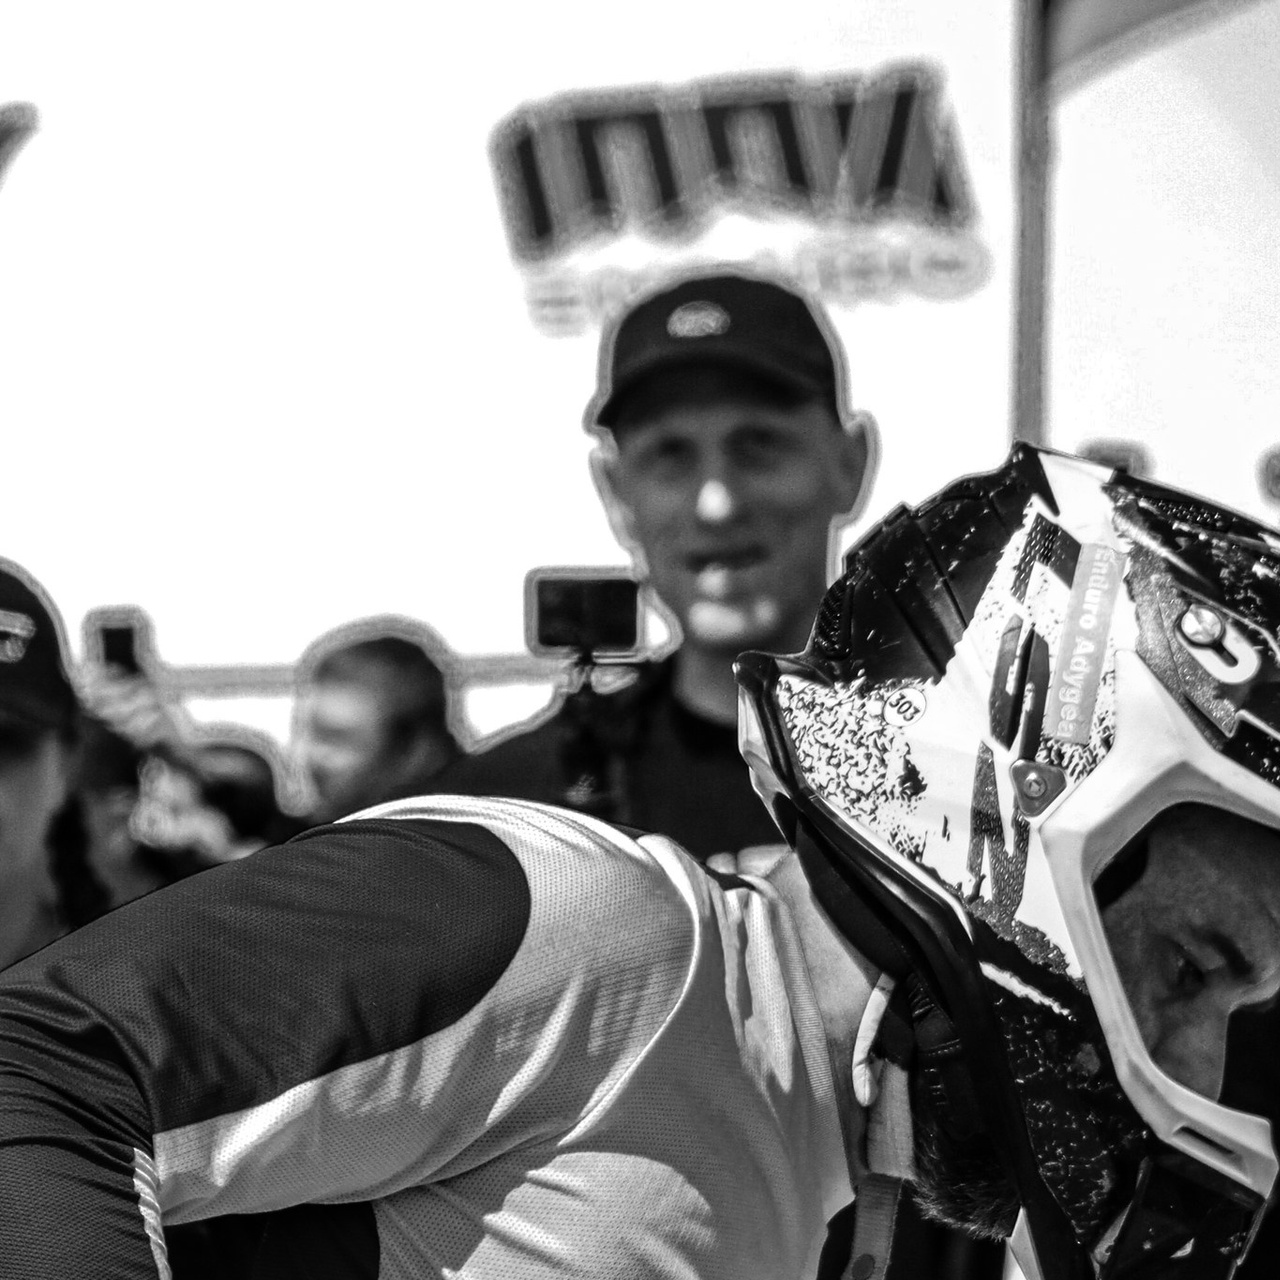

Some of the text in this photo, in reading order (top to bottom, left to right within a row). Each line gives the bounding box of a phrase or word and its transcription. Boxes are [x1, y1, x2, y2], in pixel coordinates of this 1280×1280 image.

[1056, 546, 1114, 739] Enduro Adygea
[888, 693, 921, 721] 303
